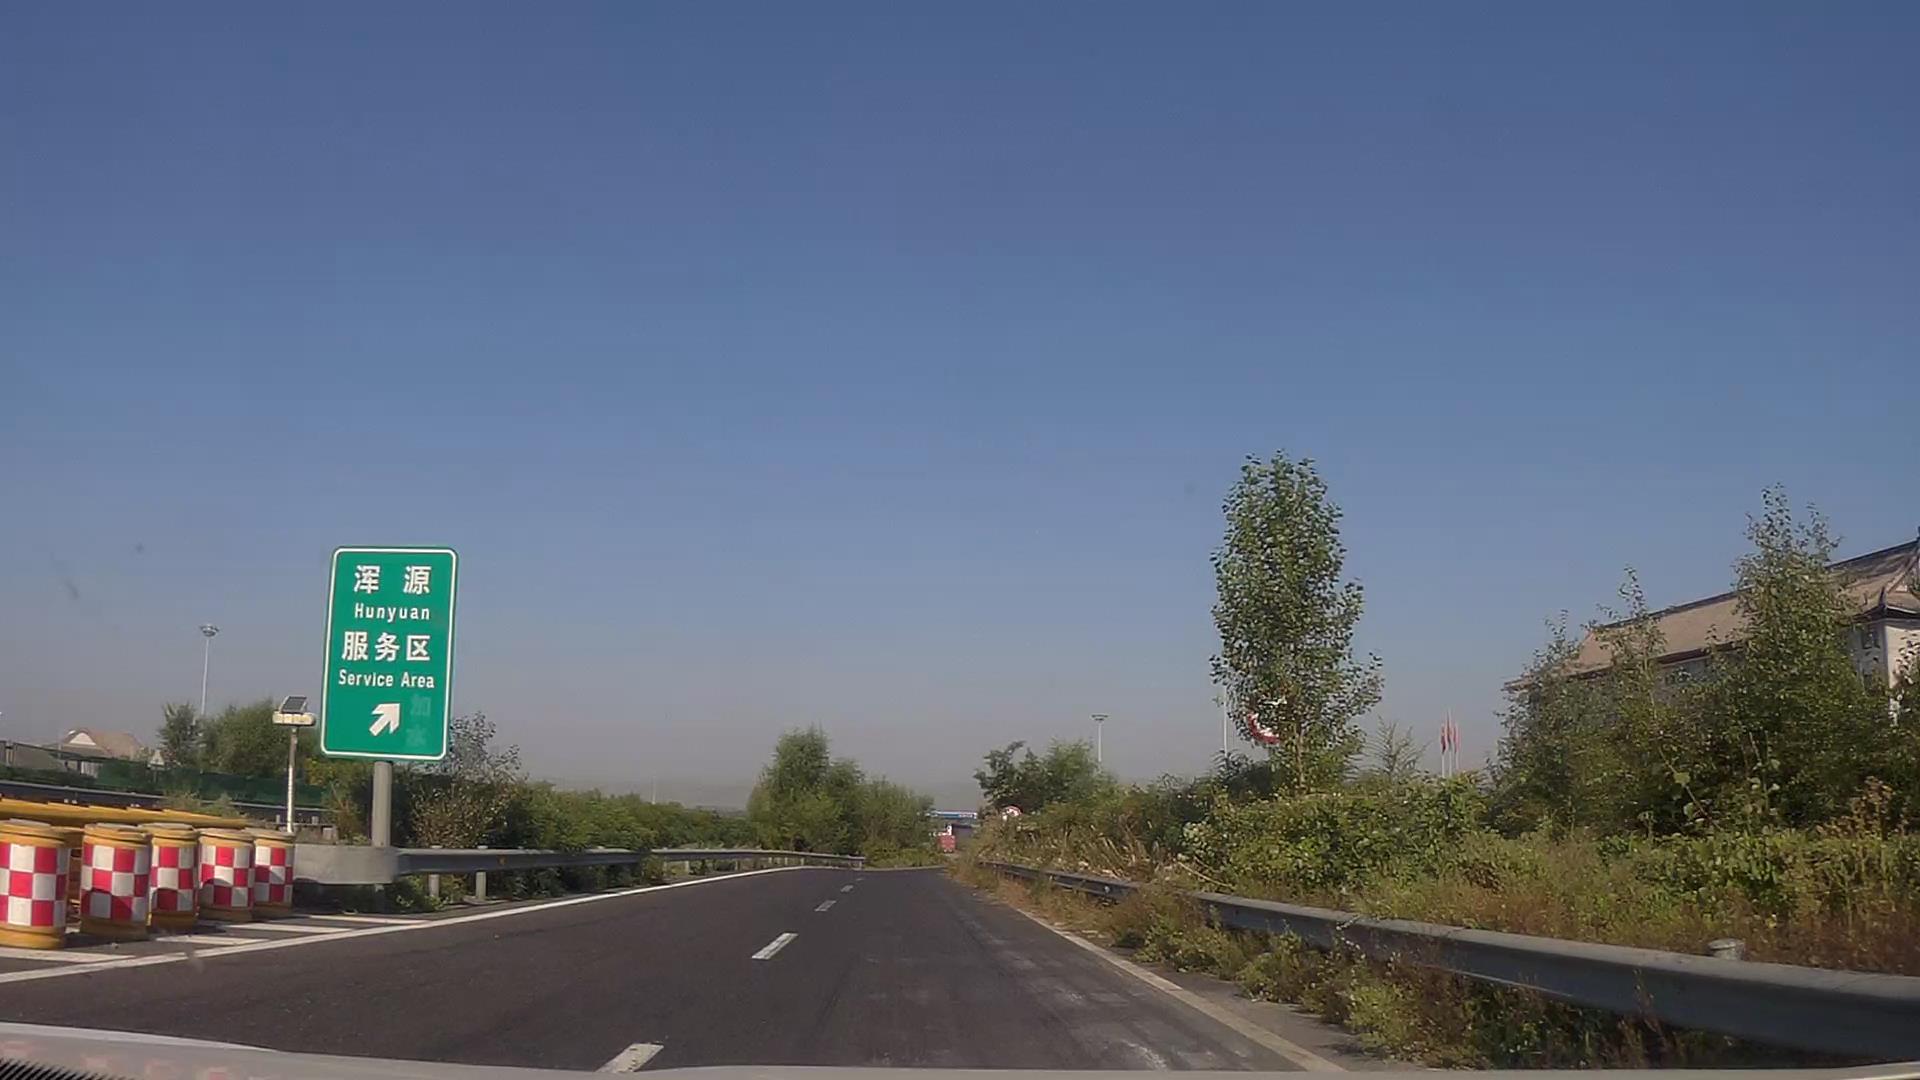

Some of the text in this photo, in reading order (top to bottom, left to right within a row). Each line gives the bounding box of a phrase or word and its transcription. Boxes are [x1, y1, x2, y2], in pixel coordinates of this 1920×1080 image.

[354, 565, 432, 595] 浑源
[354, 602, 430, 623] Hunyuan
[341, 631, 431, 662] 服务区
[338, 669, 435, 689] Service Area
